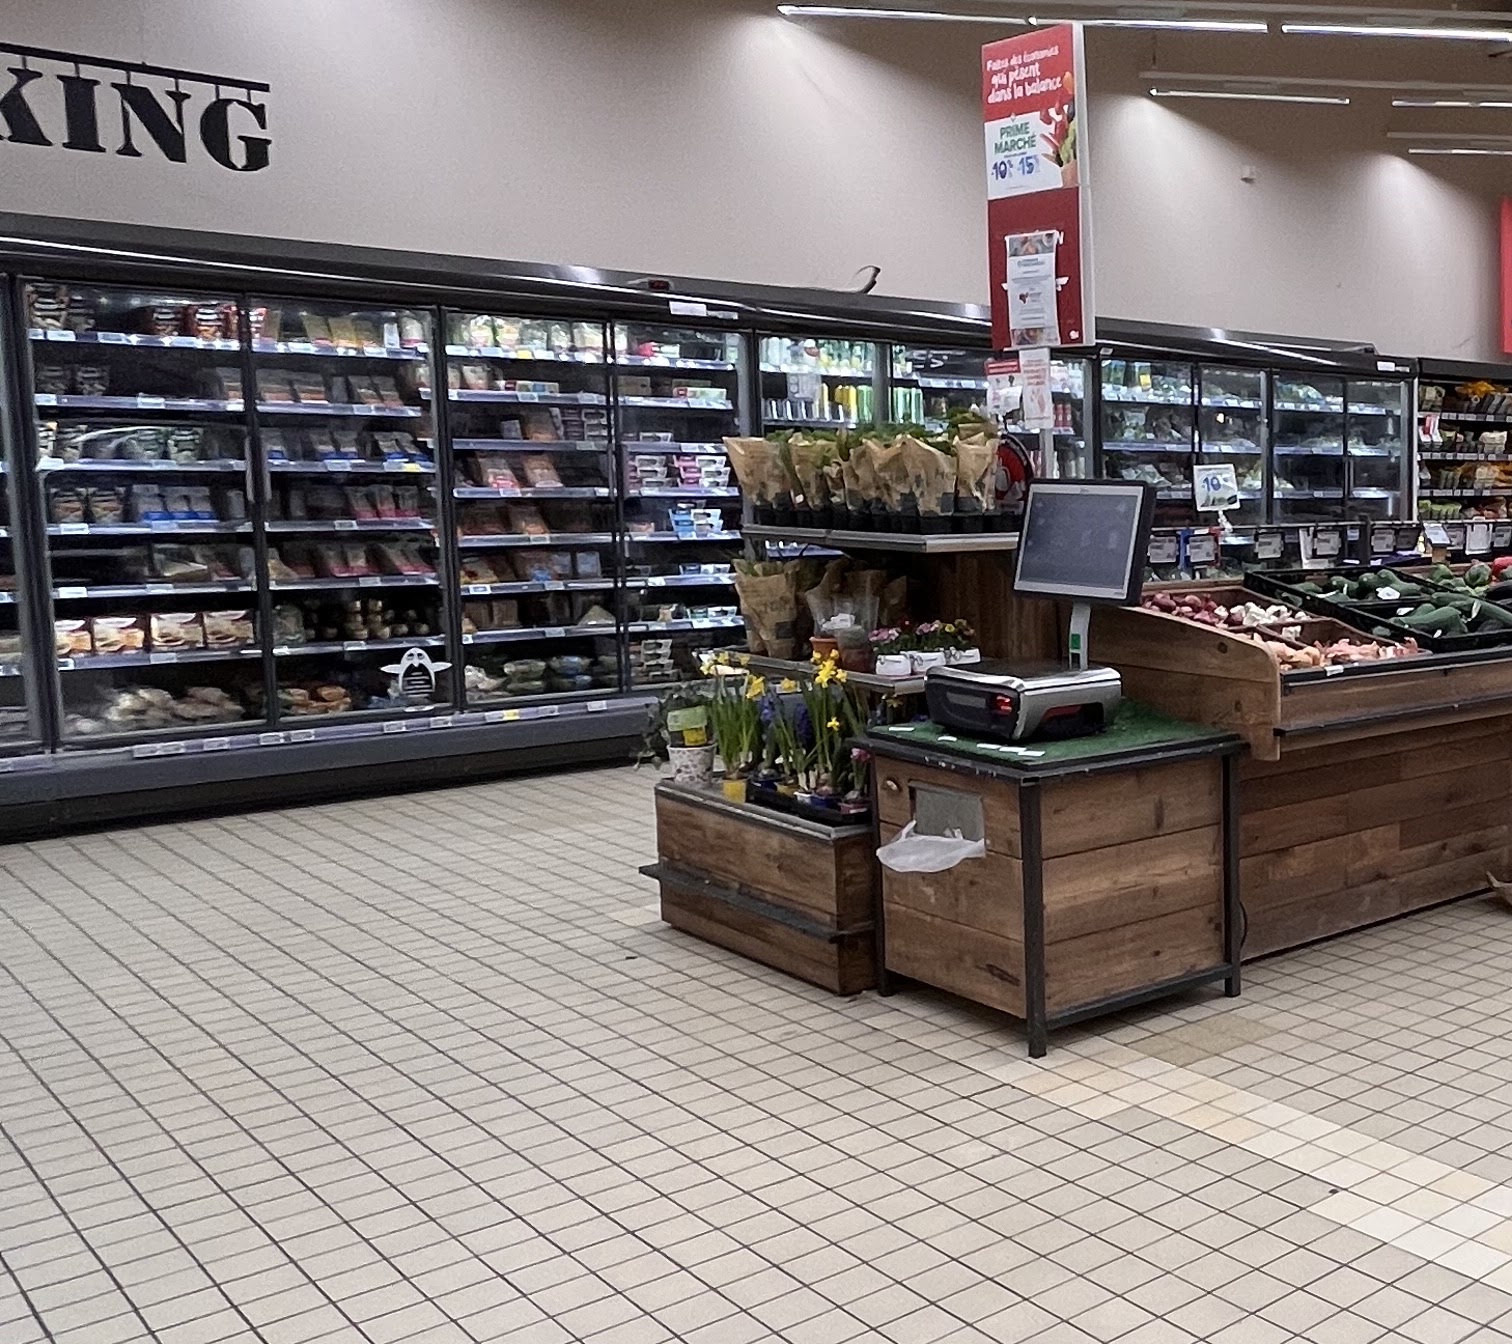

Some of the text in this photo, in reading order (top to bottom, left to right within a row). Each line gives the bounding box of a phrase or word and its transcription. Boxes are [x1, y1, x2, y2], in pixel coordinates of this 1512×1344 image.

[0, 67, 272, 172] KING
[1000, 122, 1030, 140] PRIME
[994, 132, 1036, 155] MARCHÉ
